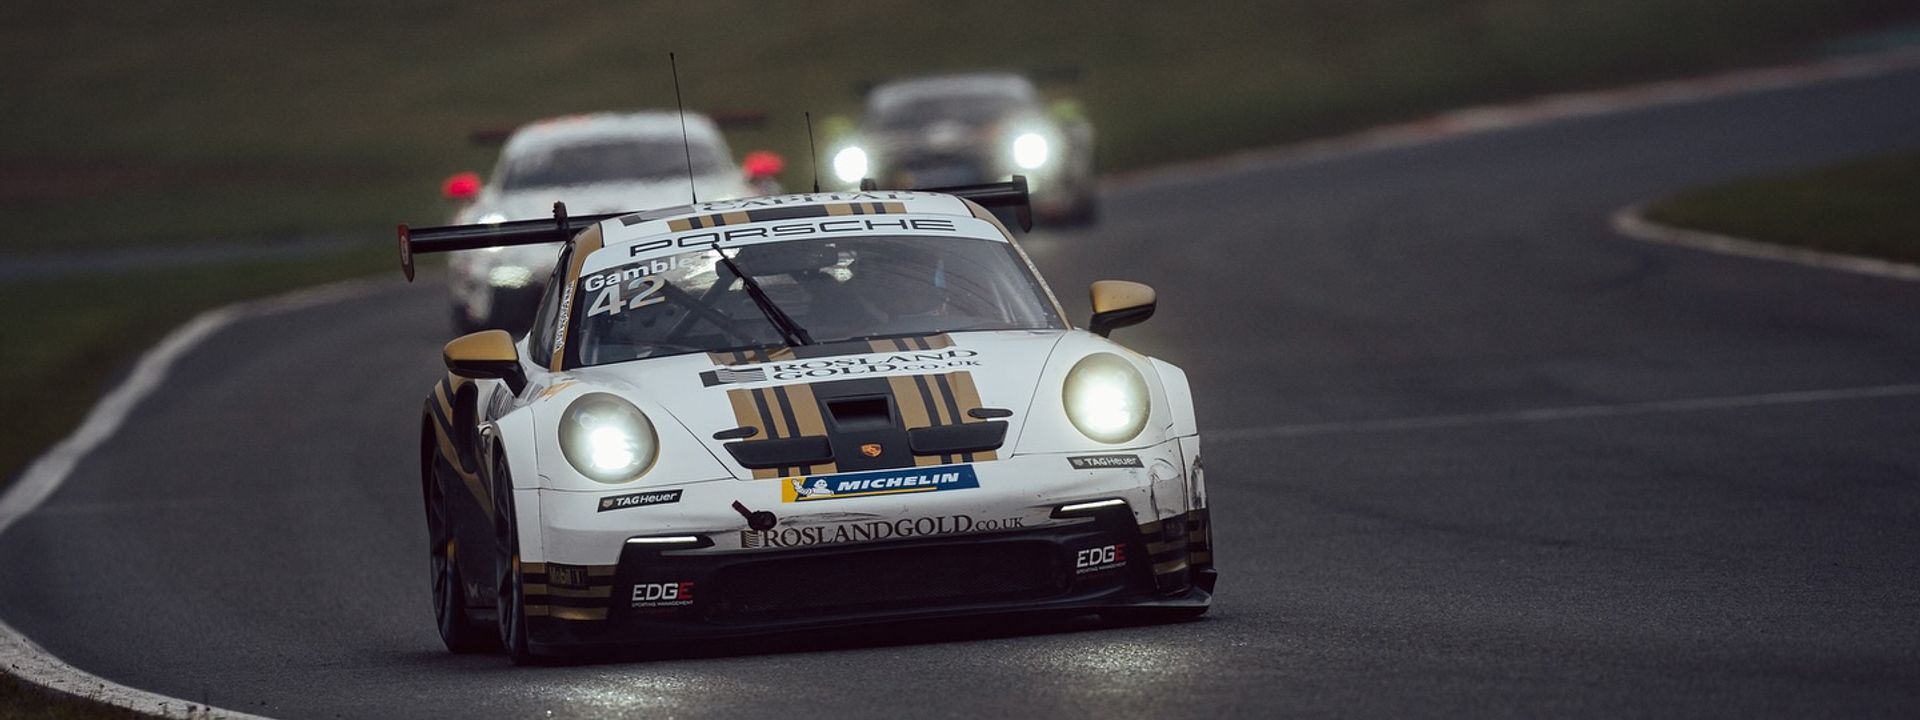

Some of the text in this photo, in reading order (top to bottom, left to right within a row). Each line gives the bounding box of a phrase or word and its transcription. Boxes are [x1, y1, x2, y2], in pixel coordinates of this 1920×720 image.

[630, 219, 956, 257] PORSCHE
[585, 256, 693, 292] Gamble
[587, 275, 666, 318] 42
[774, 349, 978, 372] ROSLAND
[837, 472, 960, 492] MICHELIN
[1076, 543, 1127, 569] EDGE
[632, 581, 695, 602] EDGE
